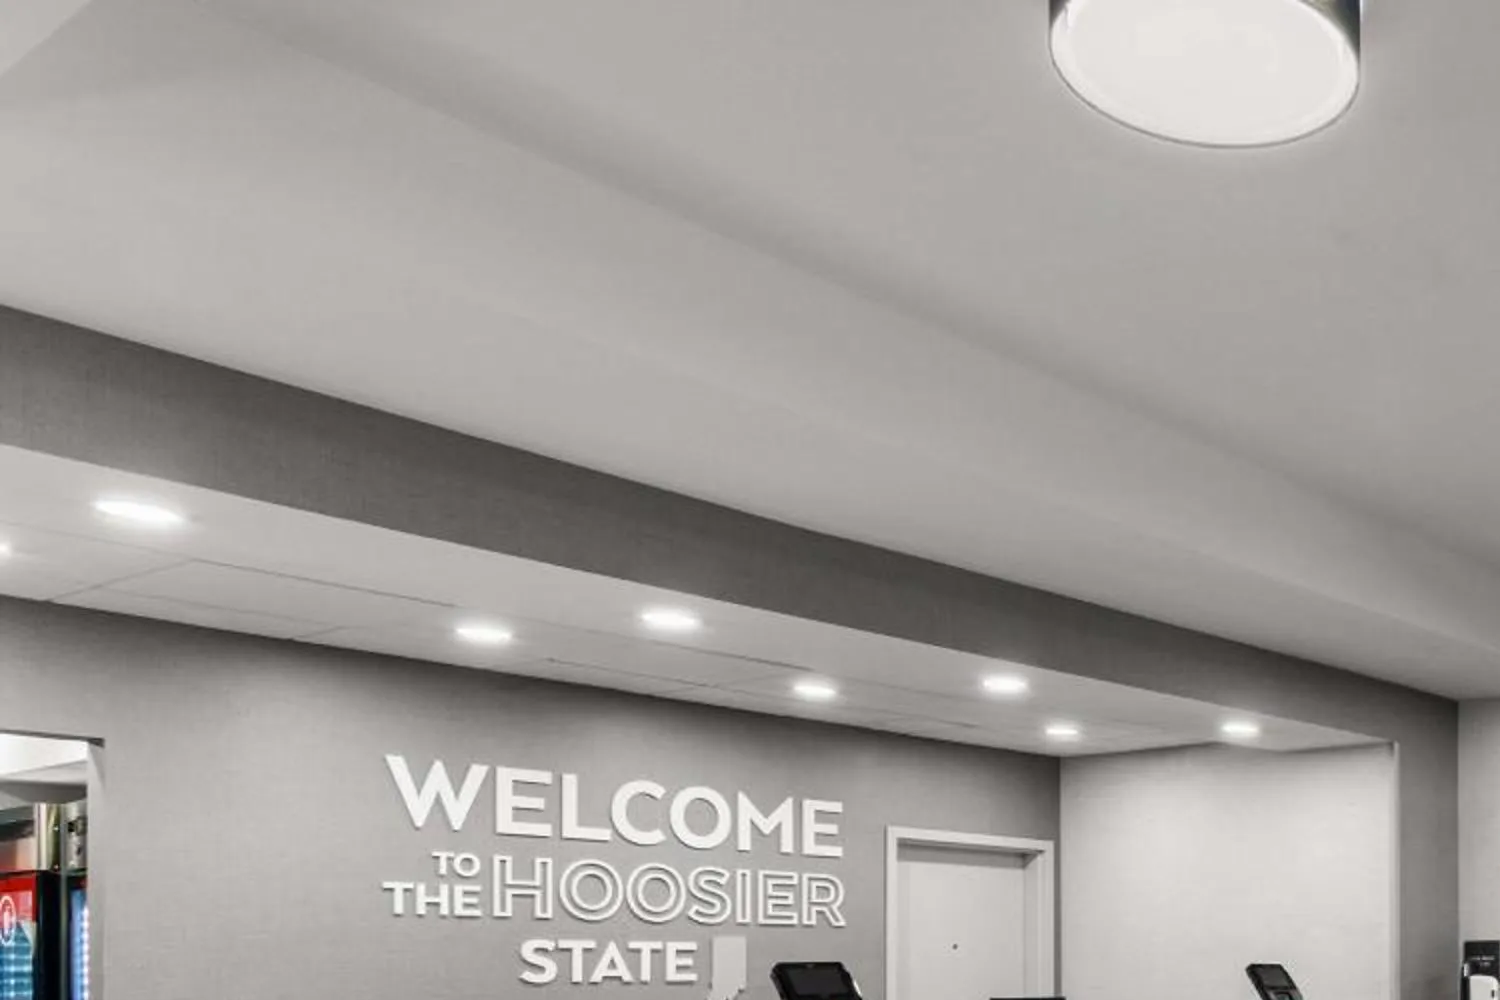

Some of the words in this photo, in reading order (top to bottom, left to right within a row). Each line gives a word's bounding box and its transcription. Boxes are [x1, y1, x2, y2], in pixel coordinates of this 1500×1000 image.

[385, 753, 844, 857] WELCOME
[382, 881, 483, 919] THE
[493, 854, 847, 928] HOOSIER
[431, 851, 482, 878] TO
[518, 938, 699, 986] STATE
